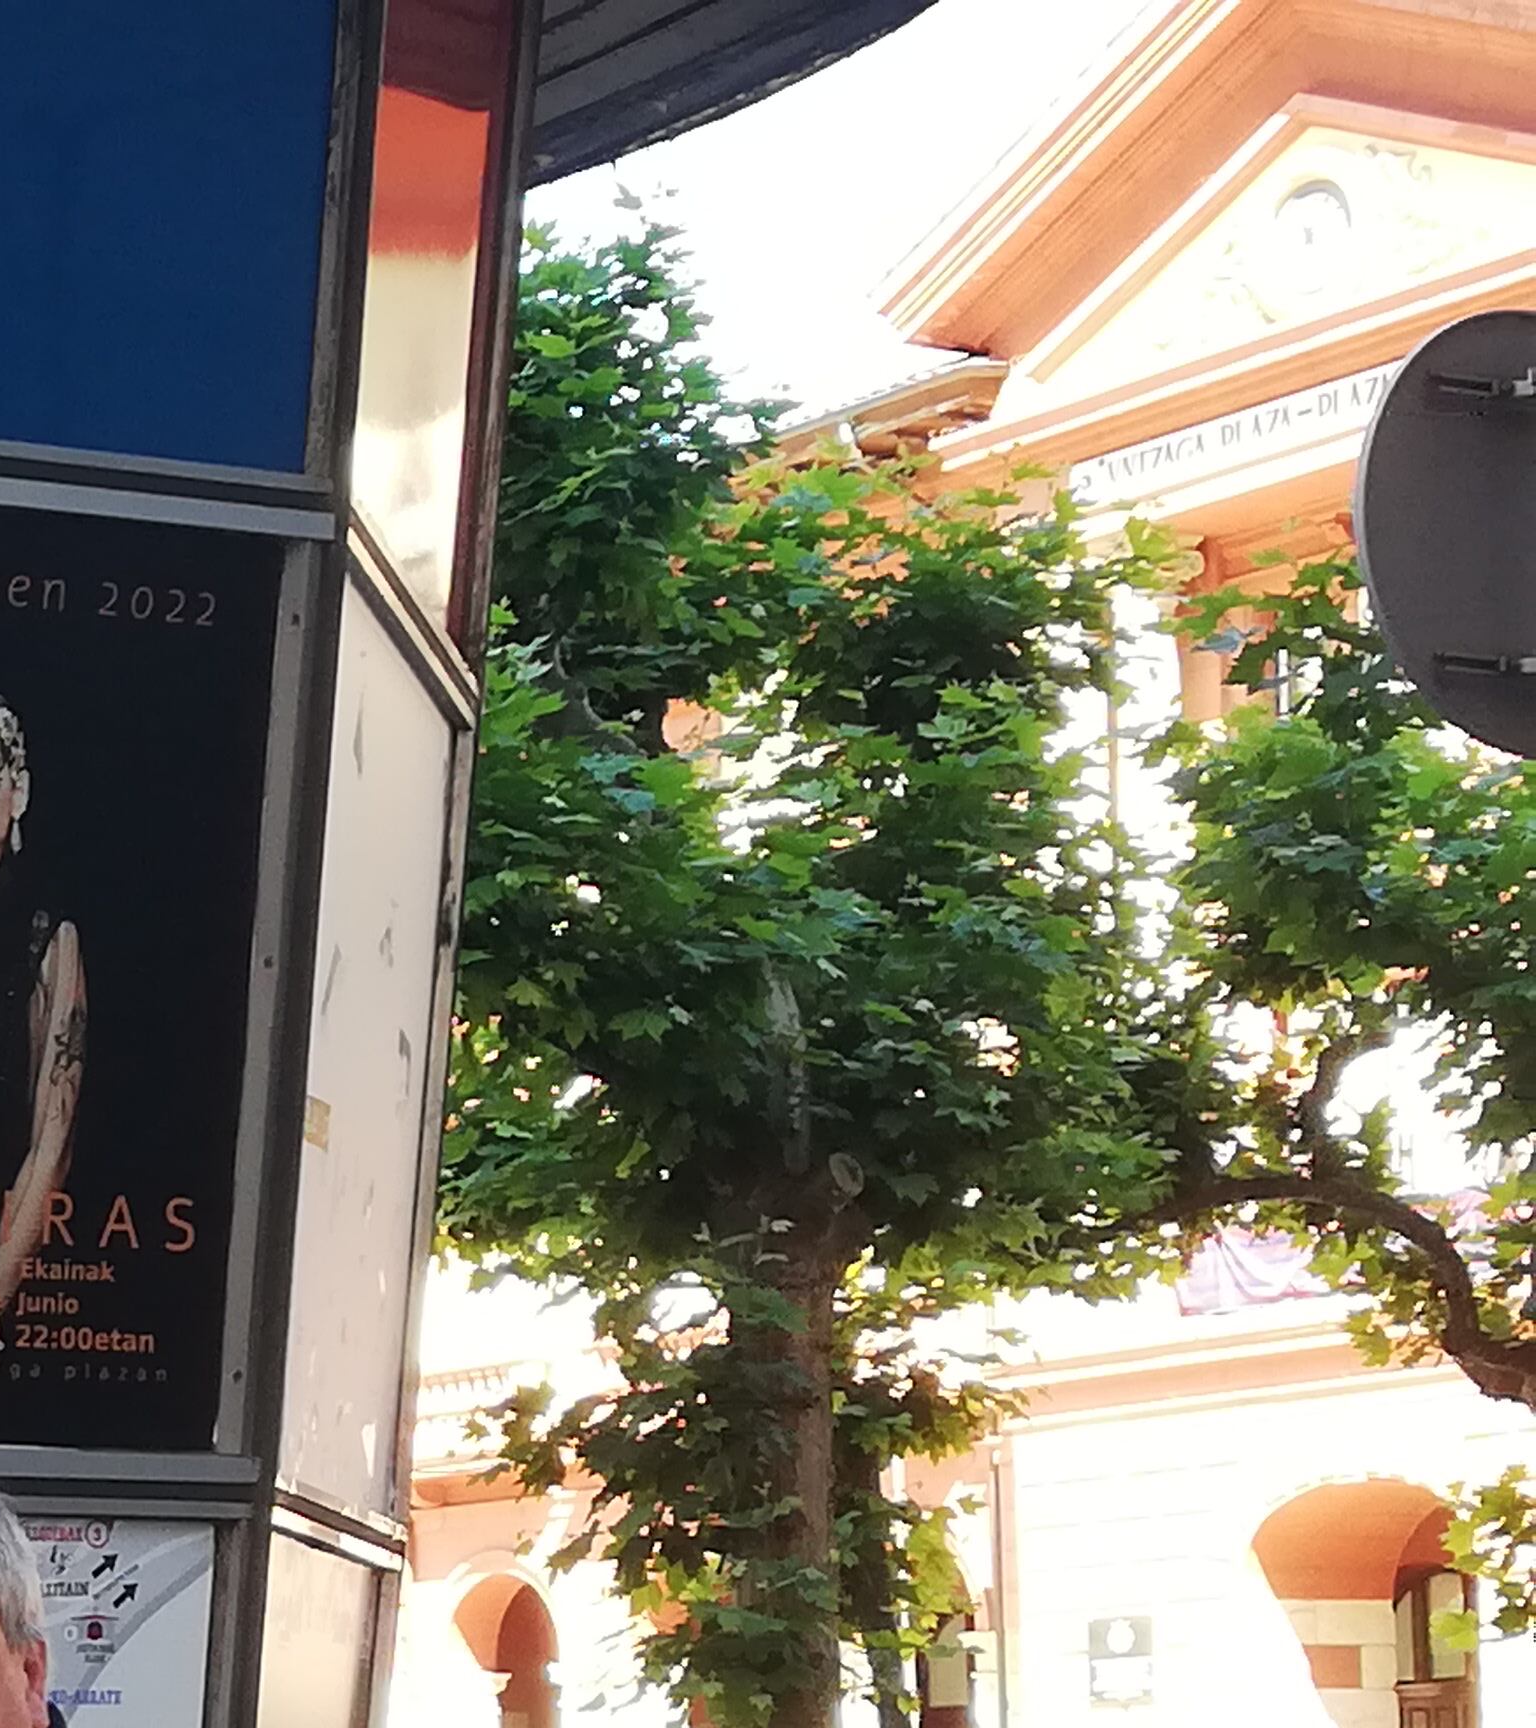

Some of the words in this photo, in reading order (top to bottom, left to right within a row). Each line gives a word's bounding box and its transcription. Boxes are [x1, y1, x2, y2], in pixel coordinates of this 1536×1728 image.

[98, 581, 217, 627] 2022
[20, 1257, 116, 1283] Ekainak
[15, 1293, 79, 1316] Junio
[15, 1324, 156, 1354] 22:00etan
[64, 1362, 168, 1382] plazan
